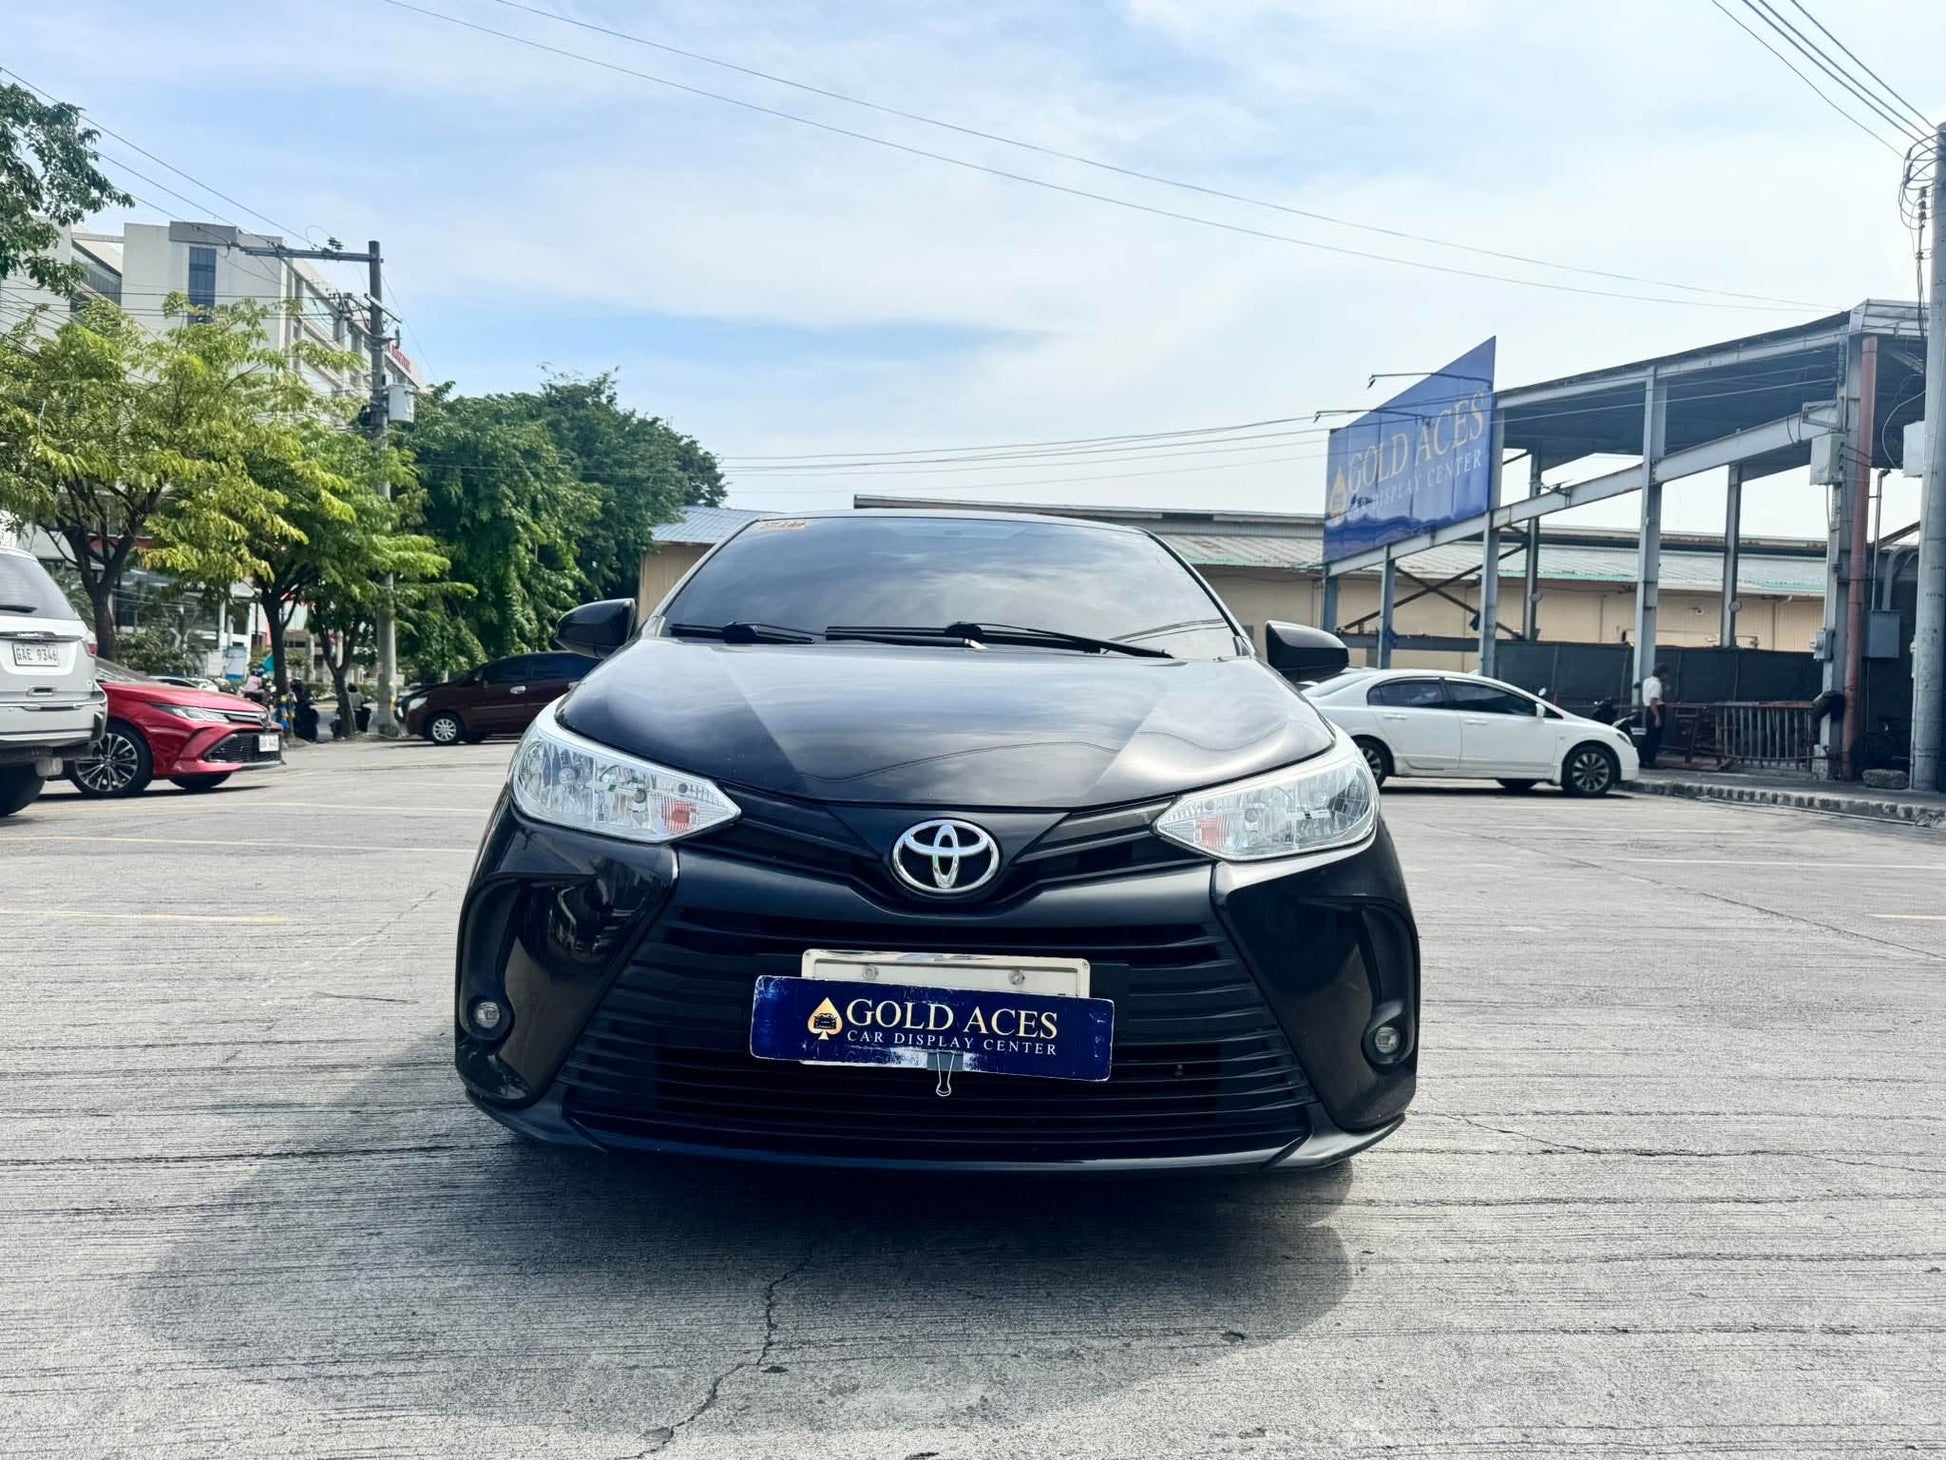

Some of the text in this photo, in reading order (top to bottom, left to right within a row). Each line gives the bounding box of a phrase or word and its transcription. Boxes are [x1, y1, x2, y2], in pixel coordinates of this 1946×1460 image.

[1348, 391, 1485, 494] GOLD ACES
[1427, 450, 1482, 487] CENTER
[15, 647, 58, 661] GAE 9346
[846, 999, 1058, 1040] GOLD ACES
[847, 1030, 1057, 1056] CAR DISPLAY CENTER
